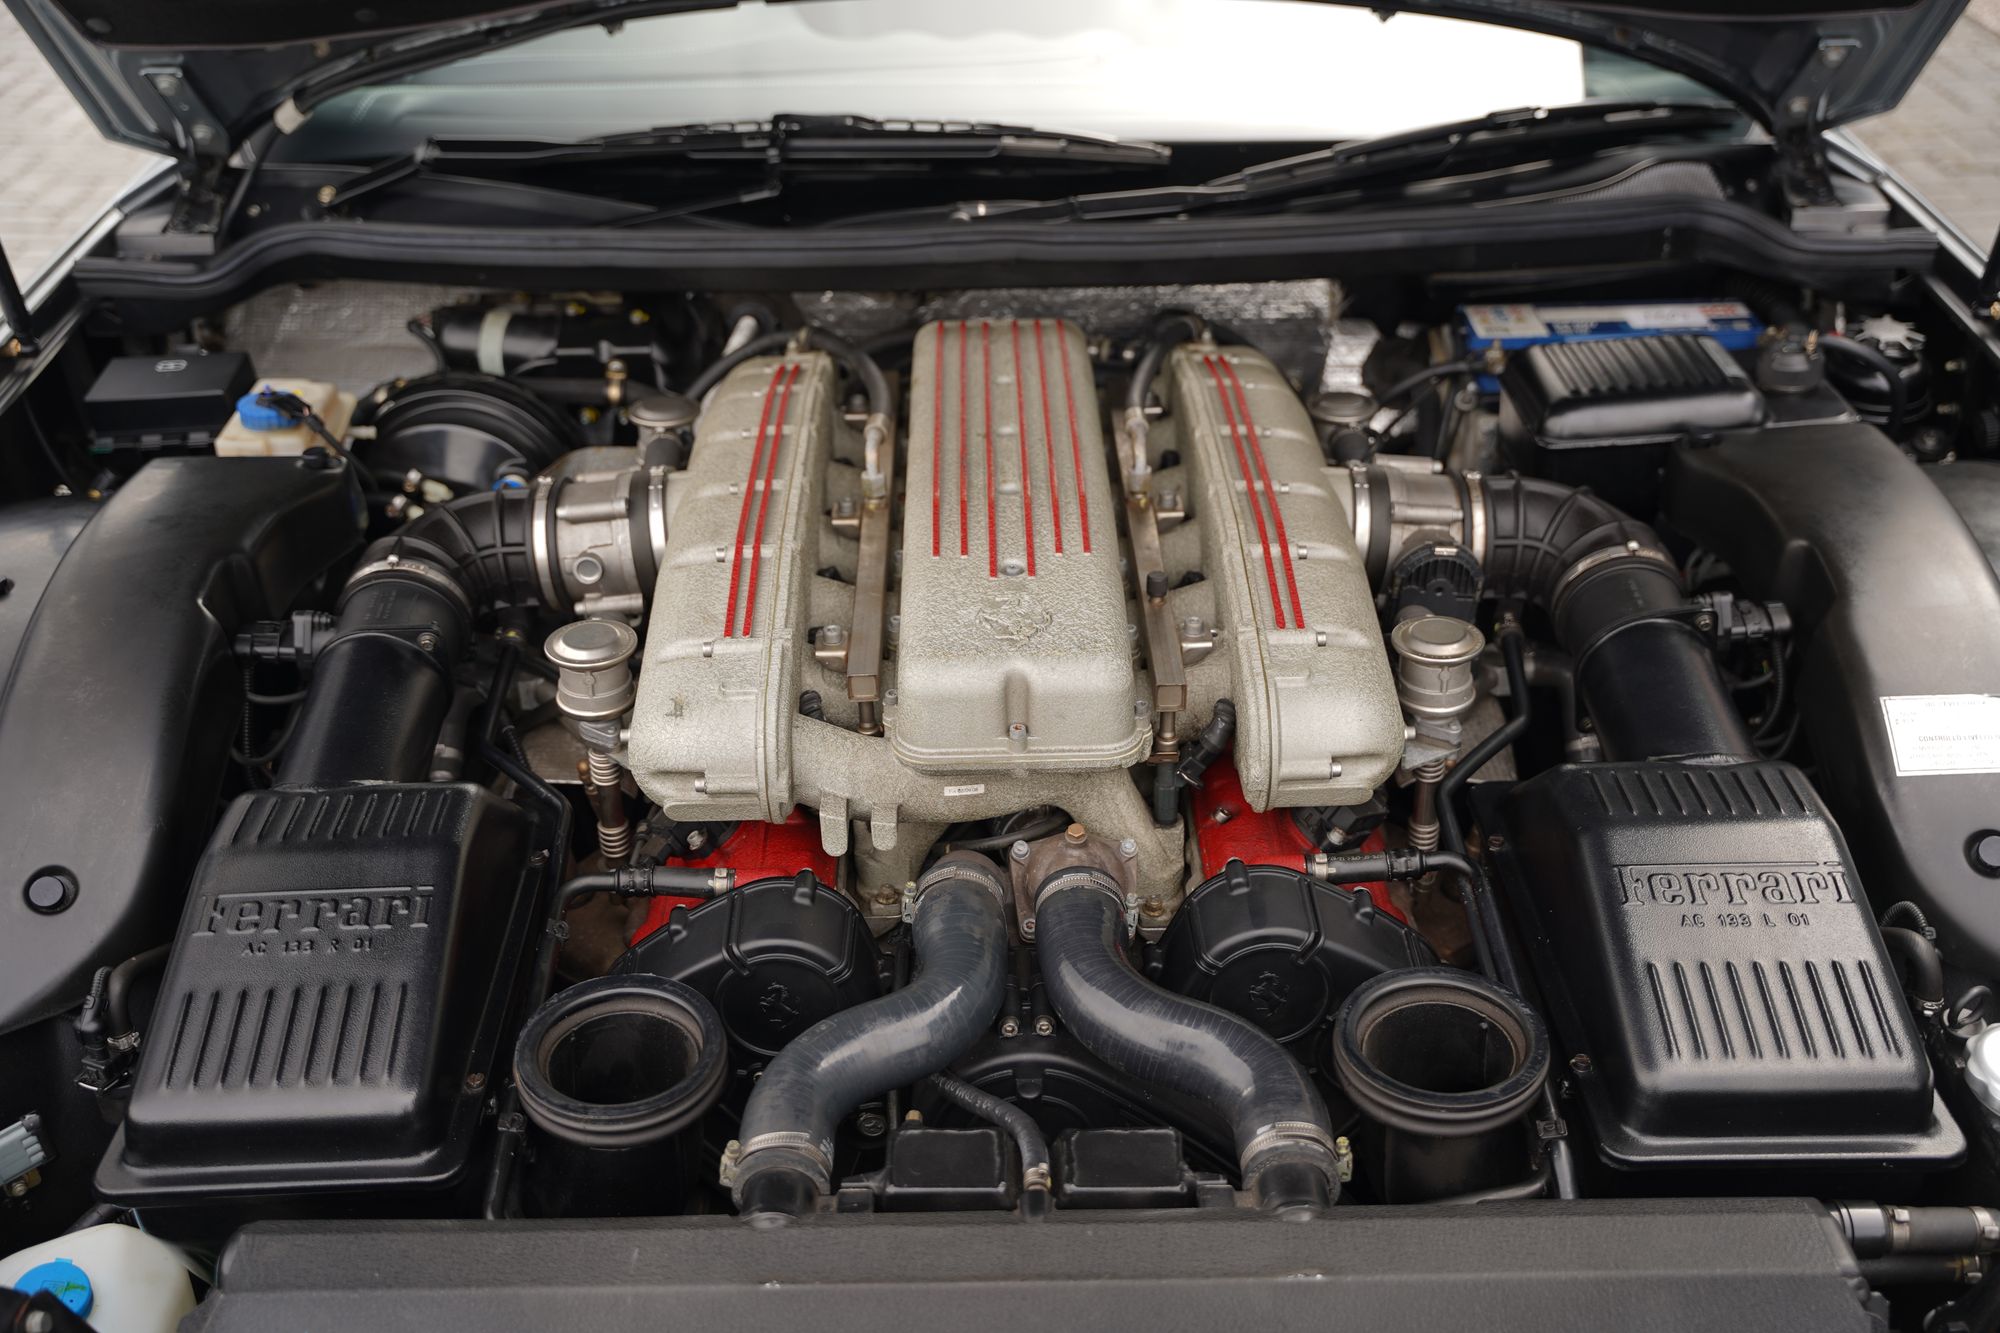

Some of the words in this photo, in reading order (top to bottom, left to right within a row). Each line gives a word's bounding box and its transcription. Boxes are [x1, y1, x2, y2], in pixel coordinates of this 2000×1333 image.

[1612, 860, 1856, 905] Ferrari
[192, 885, 434, 937] Ferrari
[1680, 913, 1705, 927] AC
[1717, 913, 1751, 927] 133
[1763, 913, 1777, 927] L
[1788, 912, 1810, 927] 01
[241, 941, 268, 956] AC
[281, 940, 315, 956] 133
[326, 938, 340, 953] R
[351, 937, 373, 952] 01
